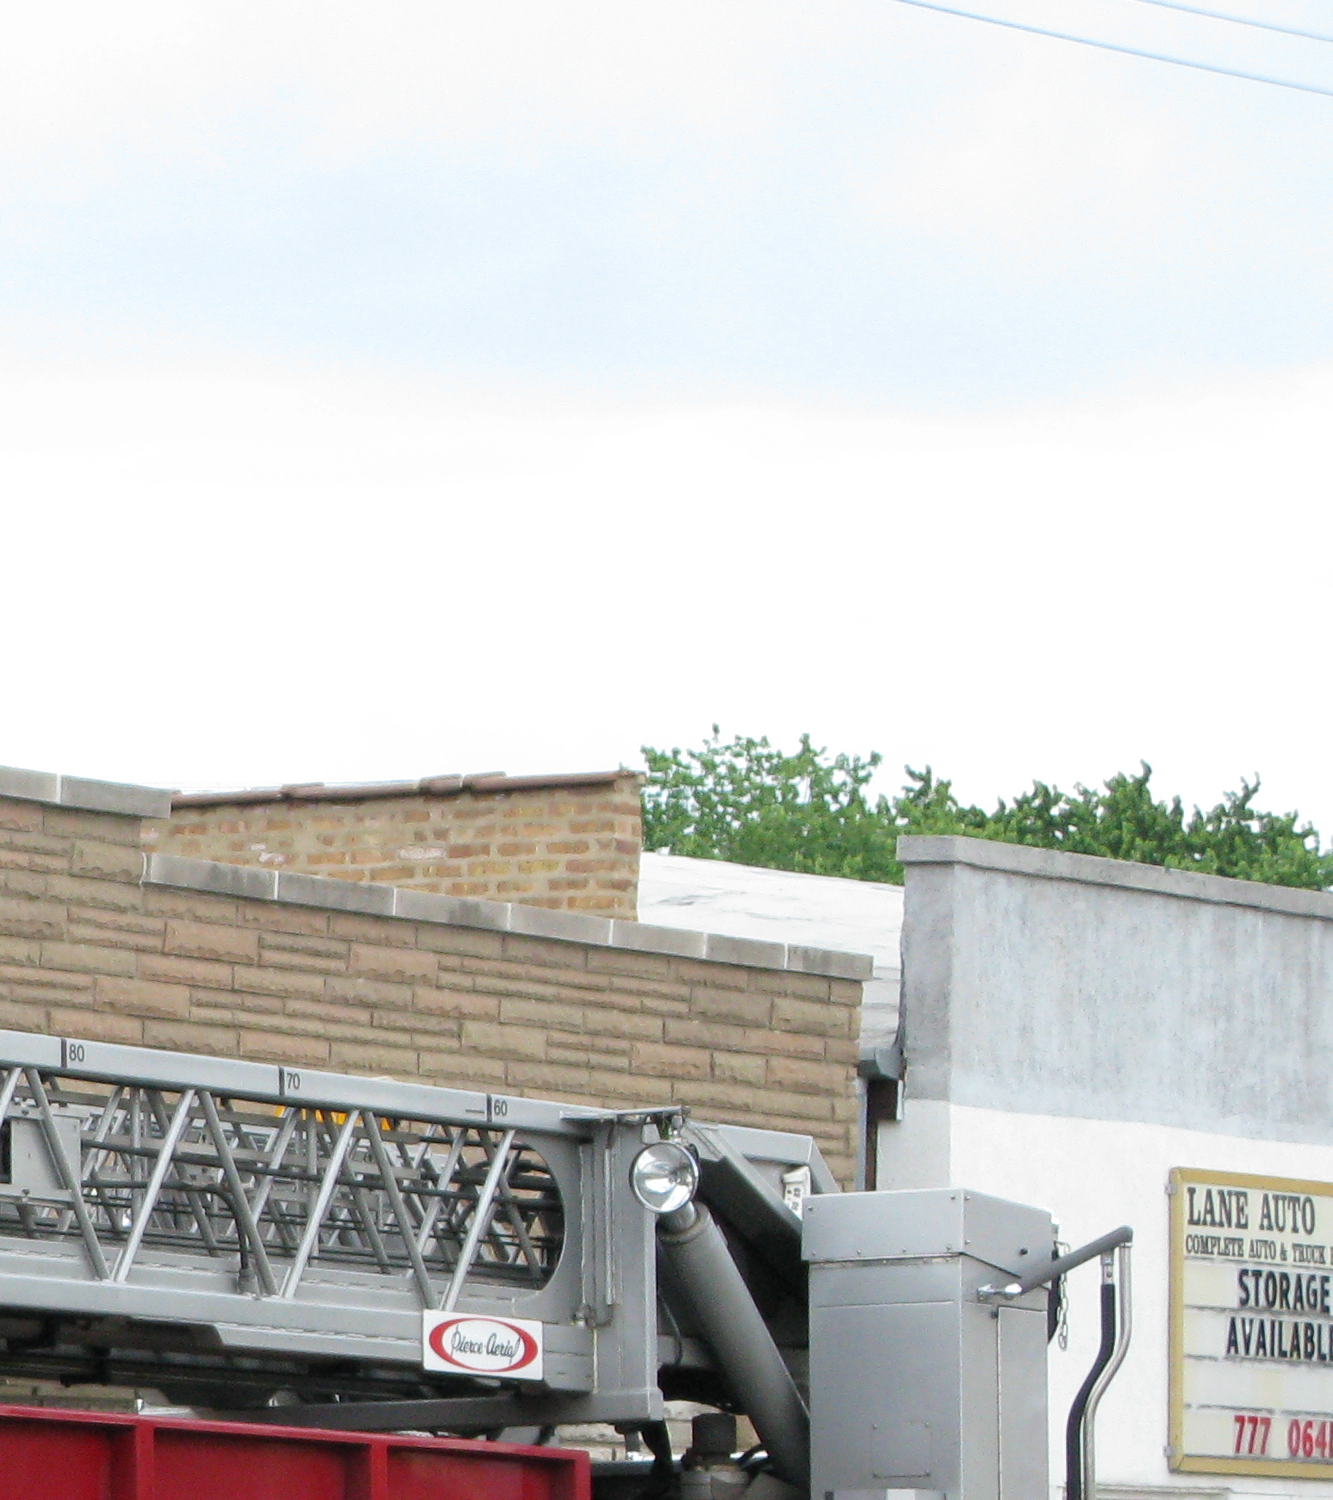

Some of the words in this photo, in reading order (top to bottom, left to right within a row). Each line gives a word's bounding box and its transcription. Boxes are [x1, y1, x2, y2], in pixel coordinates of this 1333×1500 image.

[68, 1044, 85, 1062] 80
[286, 1072, 301, 1090] 70
[493, 1099, 508, 1117] 60
[1187, 1187, 1248, 1230] LANE
[1259, 1193, 1316, 1236] AUTO
[1185, 1234, 1245, 1258] COMPLETE
[1248, 1239, 1277, 1261] AUTO
[1280, 1242, 1288, 1262] &
[1291, 1243, 1327, 1265] TRUCK
[1237, 1268, 1331, 1314] STORAGE
[1234, 1415, 1271, 1455] 777
